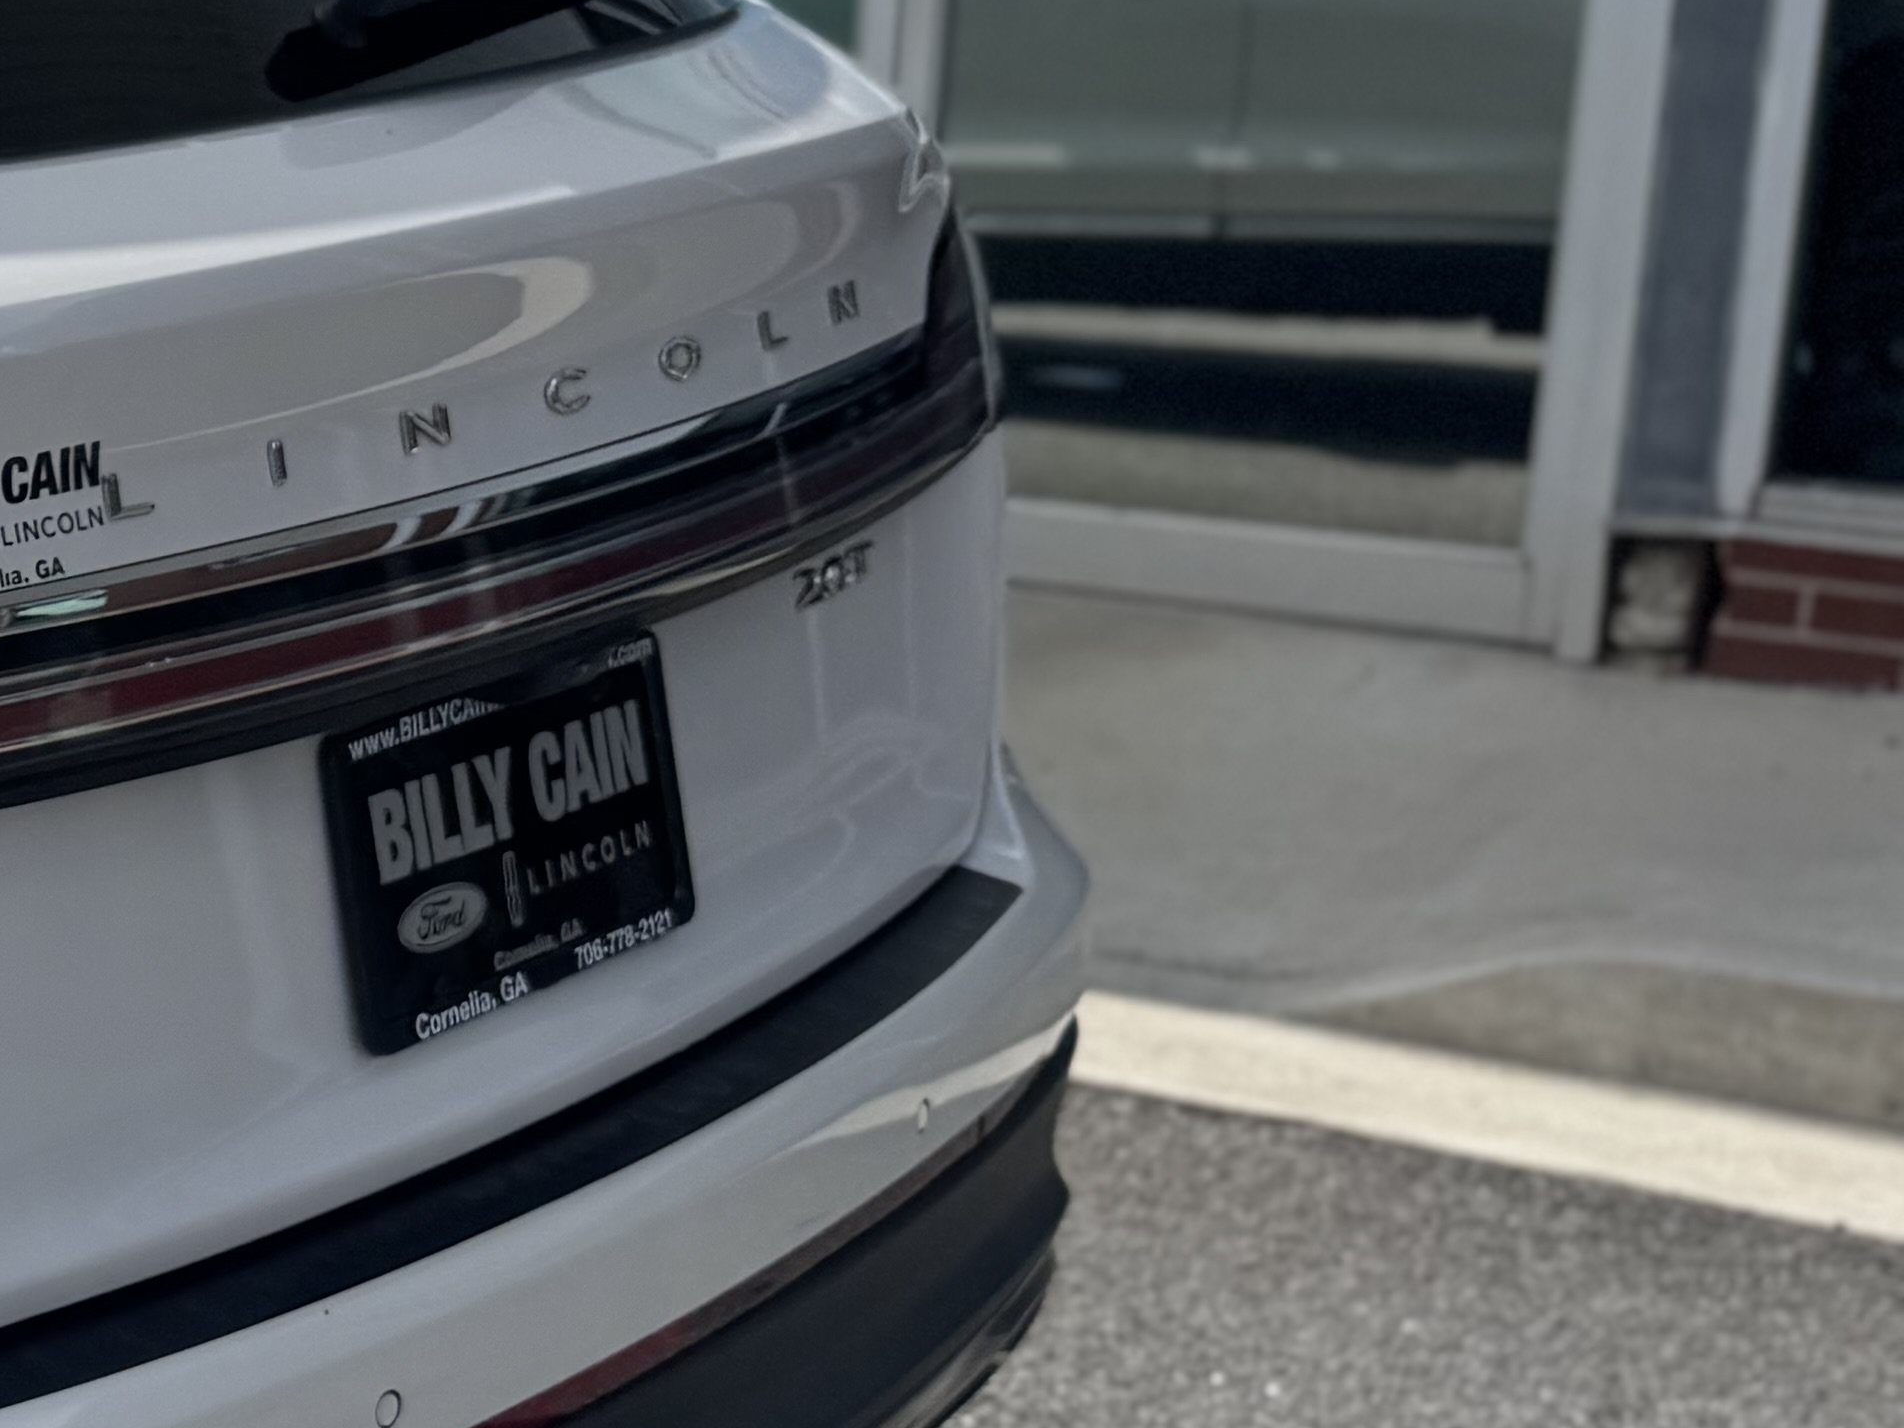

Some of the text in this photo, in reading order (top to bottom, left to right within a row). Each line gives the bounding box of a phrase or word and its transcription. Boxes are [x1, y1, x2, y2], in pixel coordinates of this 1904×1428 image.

[101, 279, 860, 521] LINCOLN
[1, 441, 100, 504] CAIN
[0, 504, 104, 547] LINCOLN
[35, 557, 66, 579] GA
[368, 699, 649, 886] BILLY CAIN
[526, 820, 651, 896] LINCOLN
[574, 907, 673, 970] 706-778-2121
[415, 971, 529, 1040] Cornelia, GA
